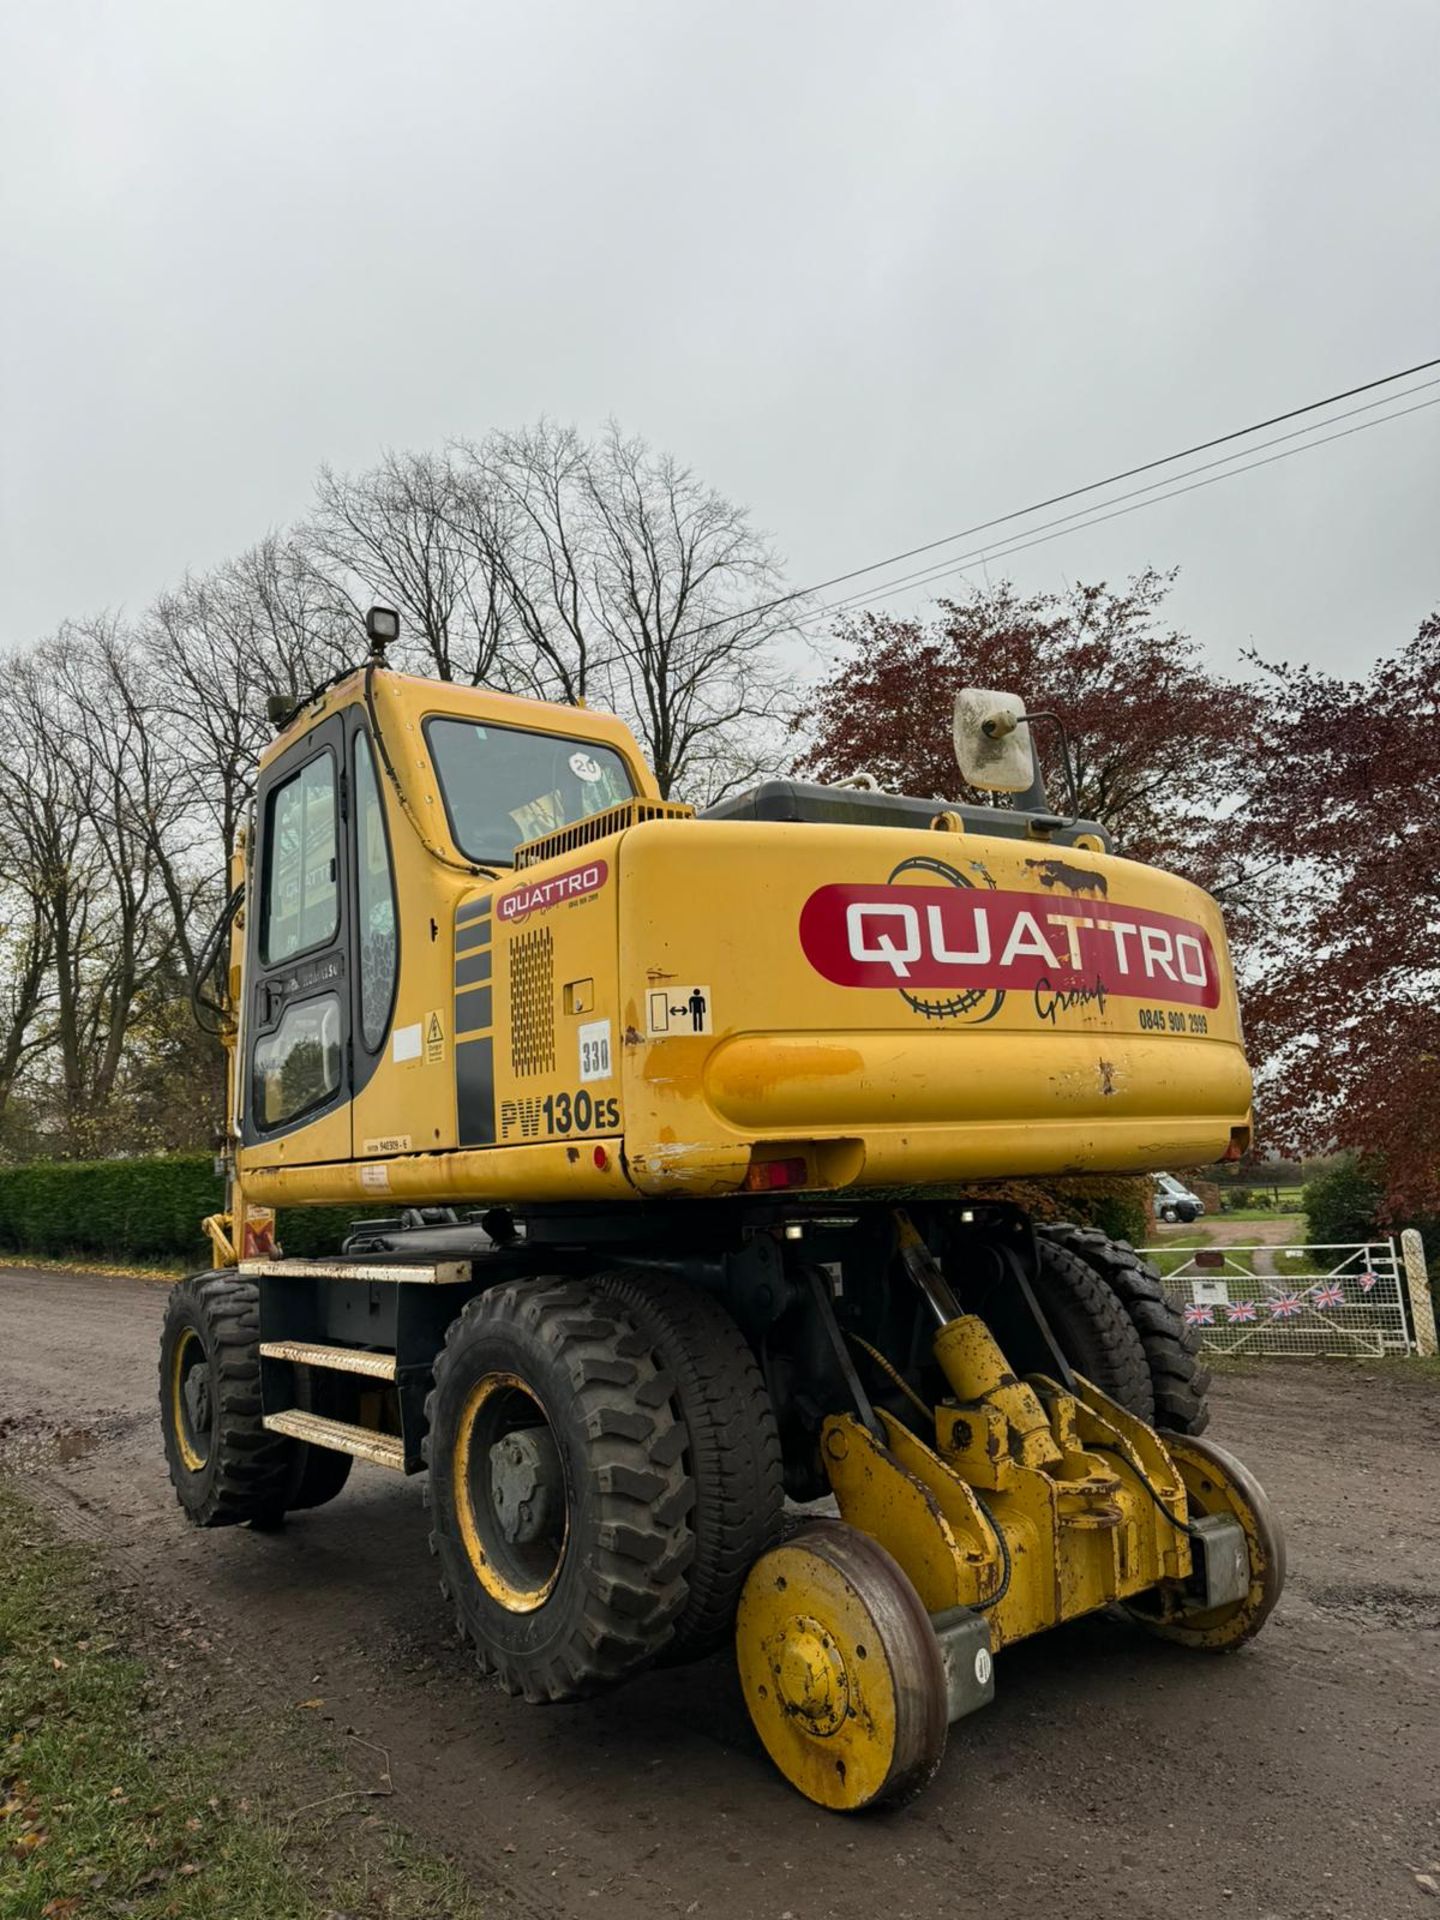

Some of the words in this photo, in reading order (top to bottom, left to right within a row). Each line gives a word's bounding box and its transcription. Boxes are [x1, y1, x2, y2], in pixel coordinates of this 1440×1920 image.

[503, 866, 599, 917] QUATTRO
[846, 903, 1208, 988] QUATTRO
[1034, 974, 1110, 1026] Group
[1139, 1008, 1166, 1031] 0845
[1168, 1011, 1186, 1032] 900
[583, 1039, 609, 1073] 330
